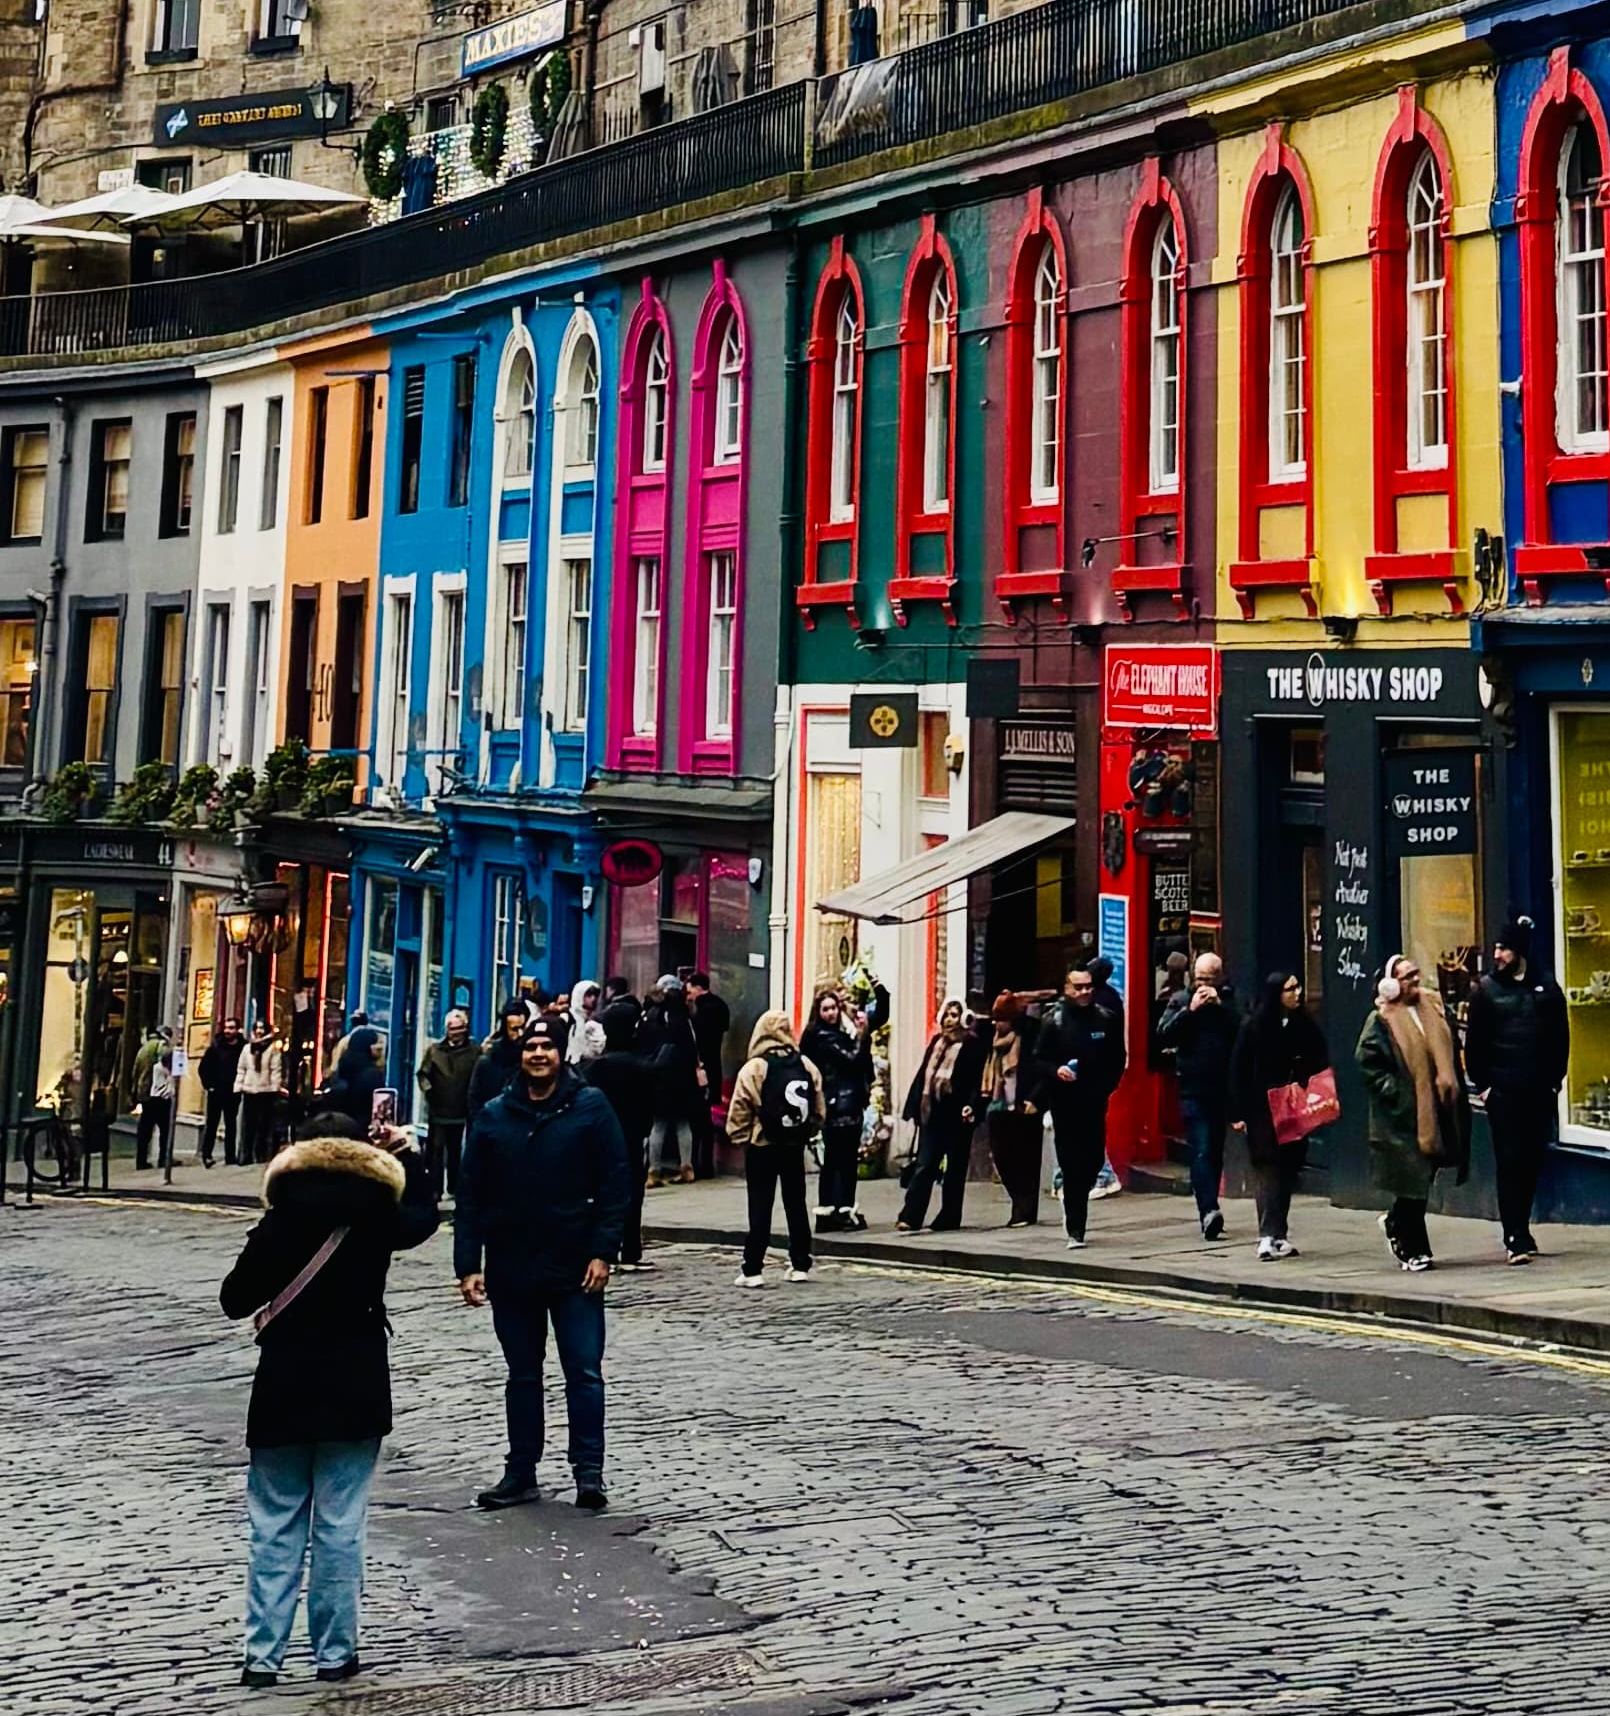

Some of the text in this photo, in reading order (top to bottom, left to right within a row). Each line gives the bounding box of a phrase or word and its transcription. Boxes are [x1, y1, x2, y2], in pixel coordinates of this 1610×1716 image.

[1130, 664, 1178, 696] ELEPHANT
[1177, 665, 1209, 697] HOUSE
[1267, 667, 1443, 701] THE WHISKY SHOP
[1413, 769, 1450, 785] THE
[1394, 797, 1472, 816] WHISKY
[1407, 826, 1459, 843] SHOP
